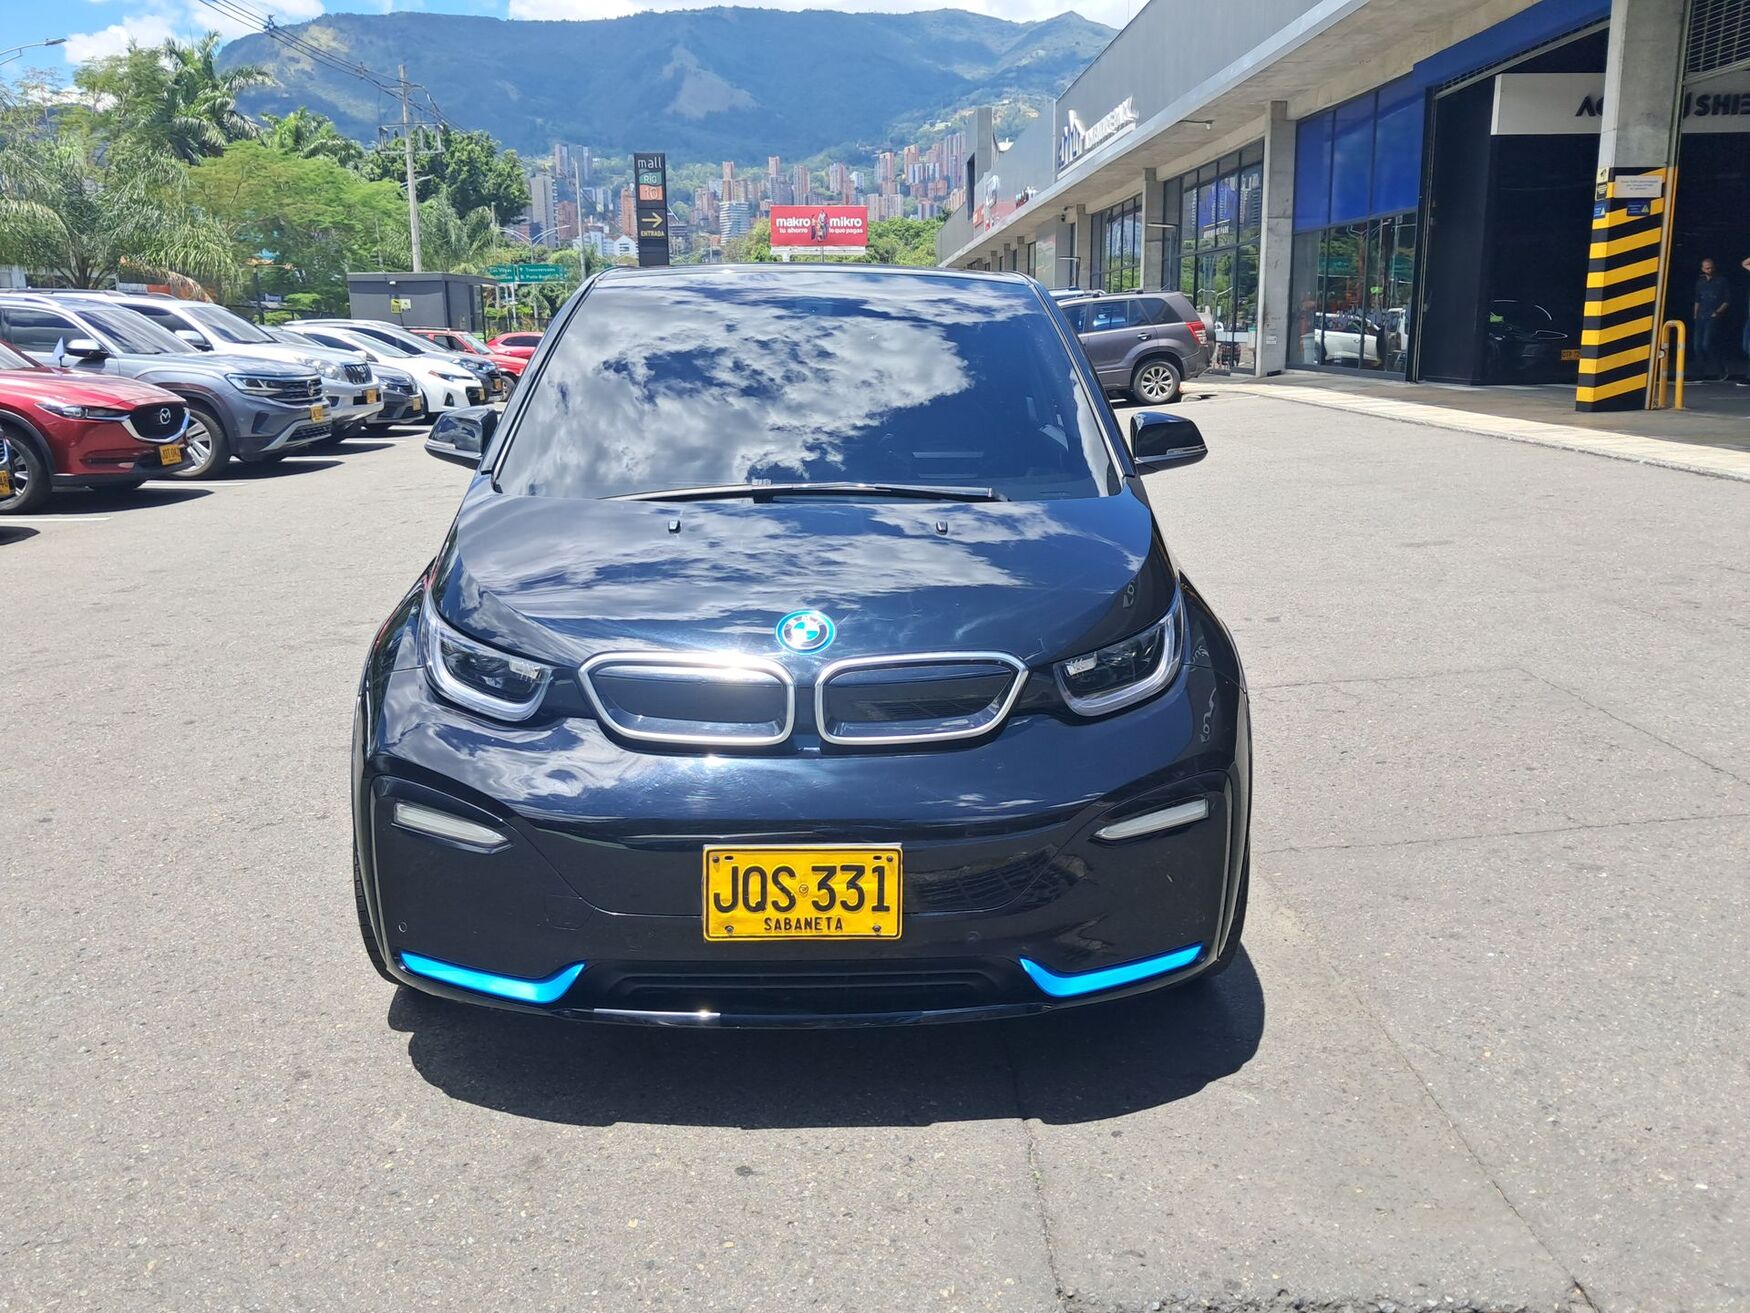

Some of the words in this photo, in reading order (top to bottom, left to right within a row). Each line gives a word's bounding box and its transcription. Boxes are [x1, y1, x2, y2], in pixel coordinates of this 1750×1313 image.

[638, 157, 662, 168] mall
[776, 217, 811, 227] makro
[830, 217, 862, 227] mikro
[713, 865, 797, 912] JQS
[811, 865, 890, 912] 331
[763, 917, 843, 931] SABANETA
